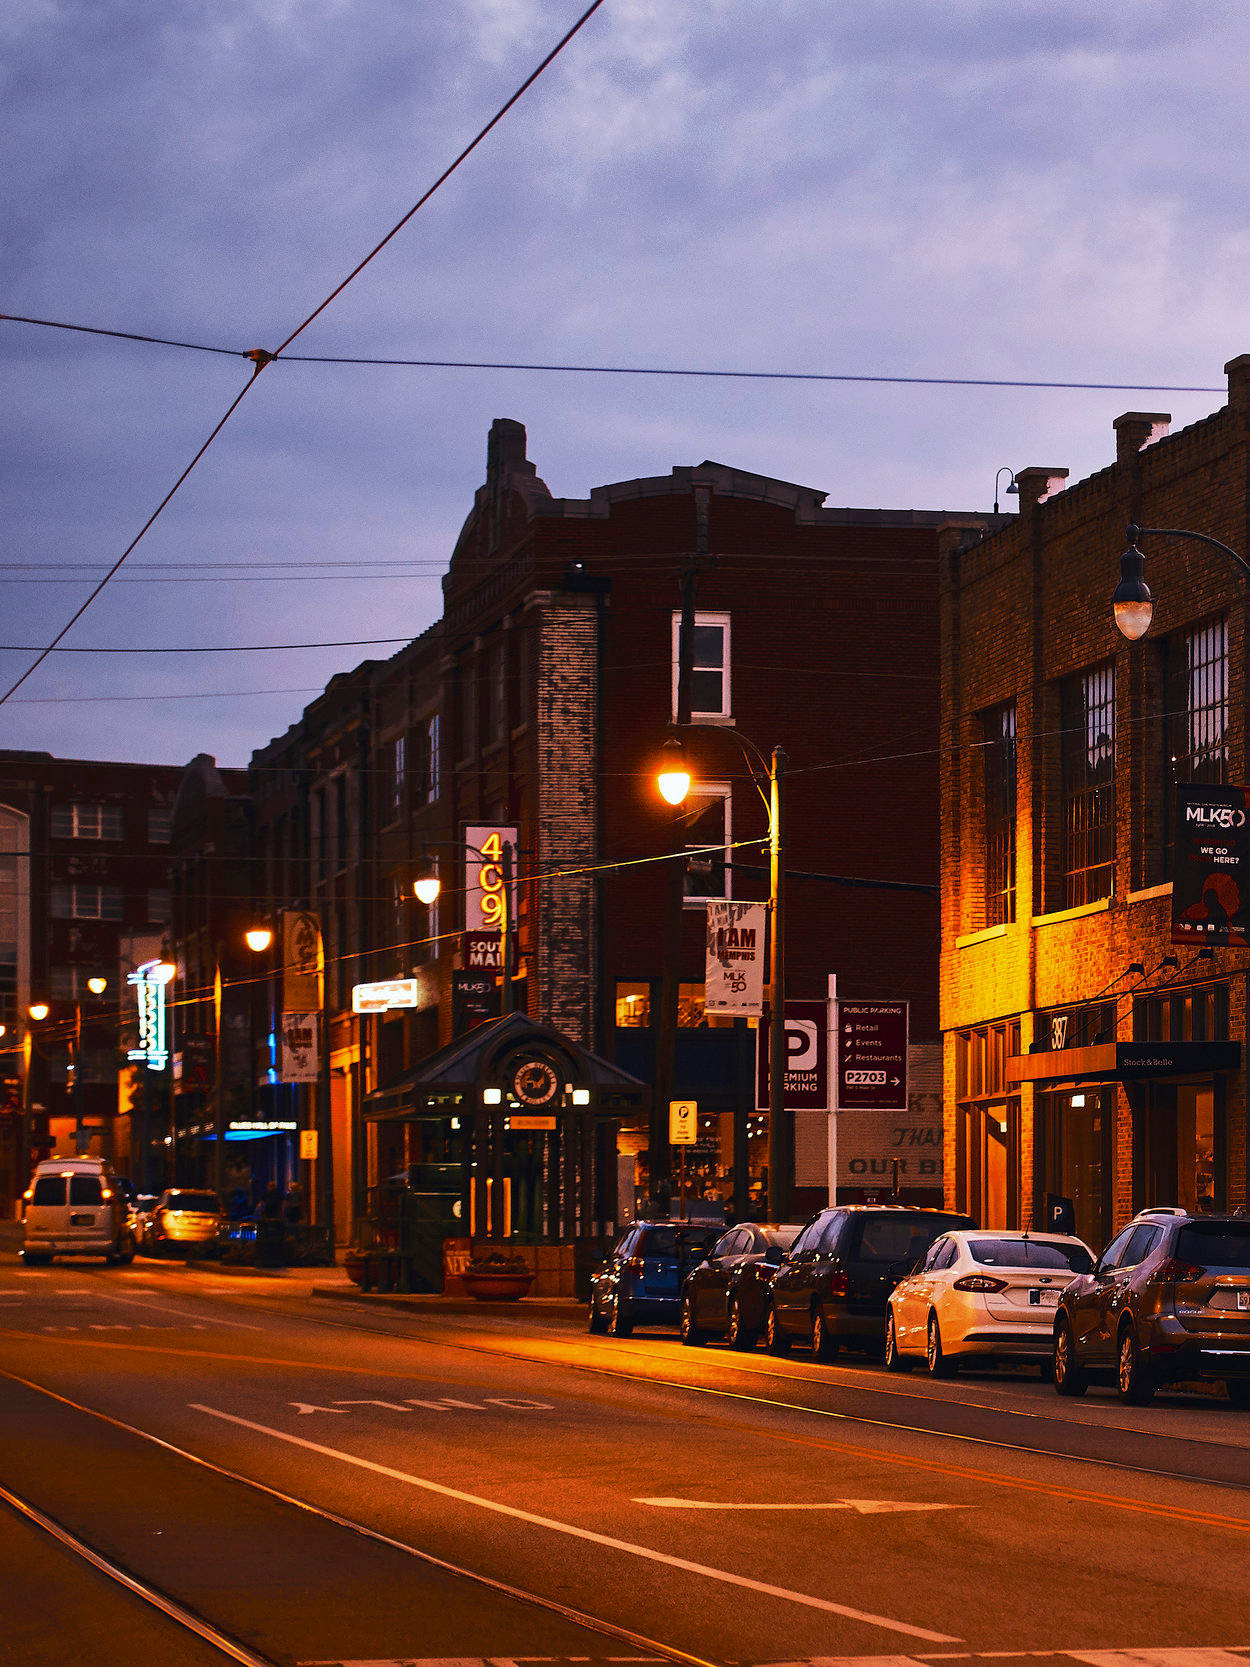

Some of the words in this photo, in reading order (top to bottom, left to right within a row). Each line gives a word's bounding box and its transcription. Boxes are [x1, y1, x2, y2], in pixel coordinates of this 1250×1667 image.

[1200, 846, 1214, 854] WE
[1215, 847, 1228, 855] GO
[1213, 856, 1240, 864] HERE?
[727, 927, 756, 947] AM
[470, 942, 502, 952] SOUT
[470, 954, 502, 967] MAI
[723, 972, 746, 981] MLK
[1052, 1016, 1068, 1050] 387
[847, 1072, 885, 1083] P2703
